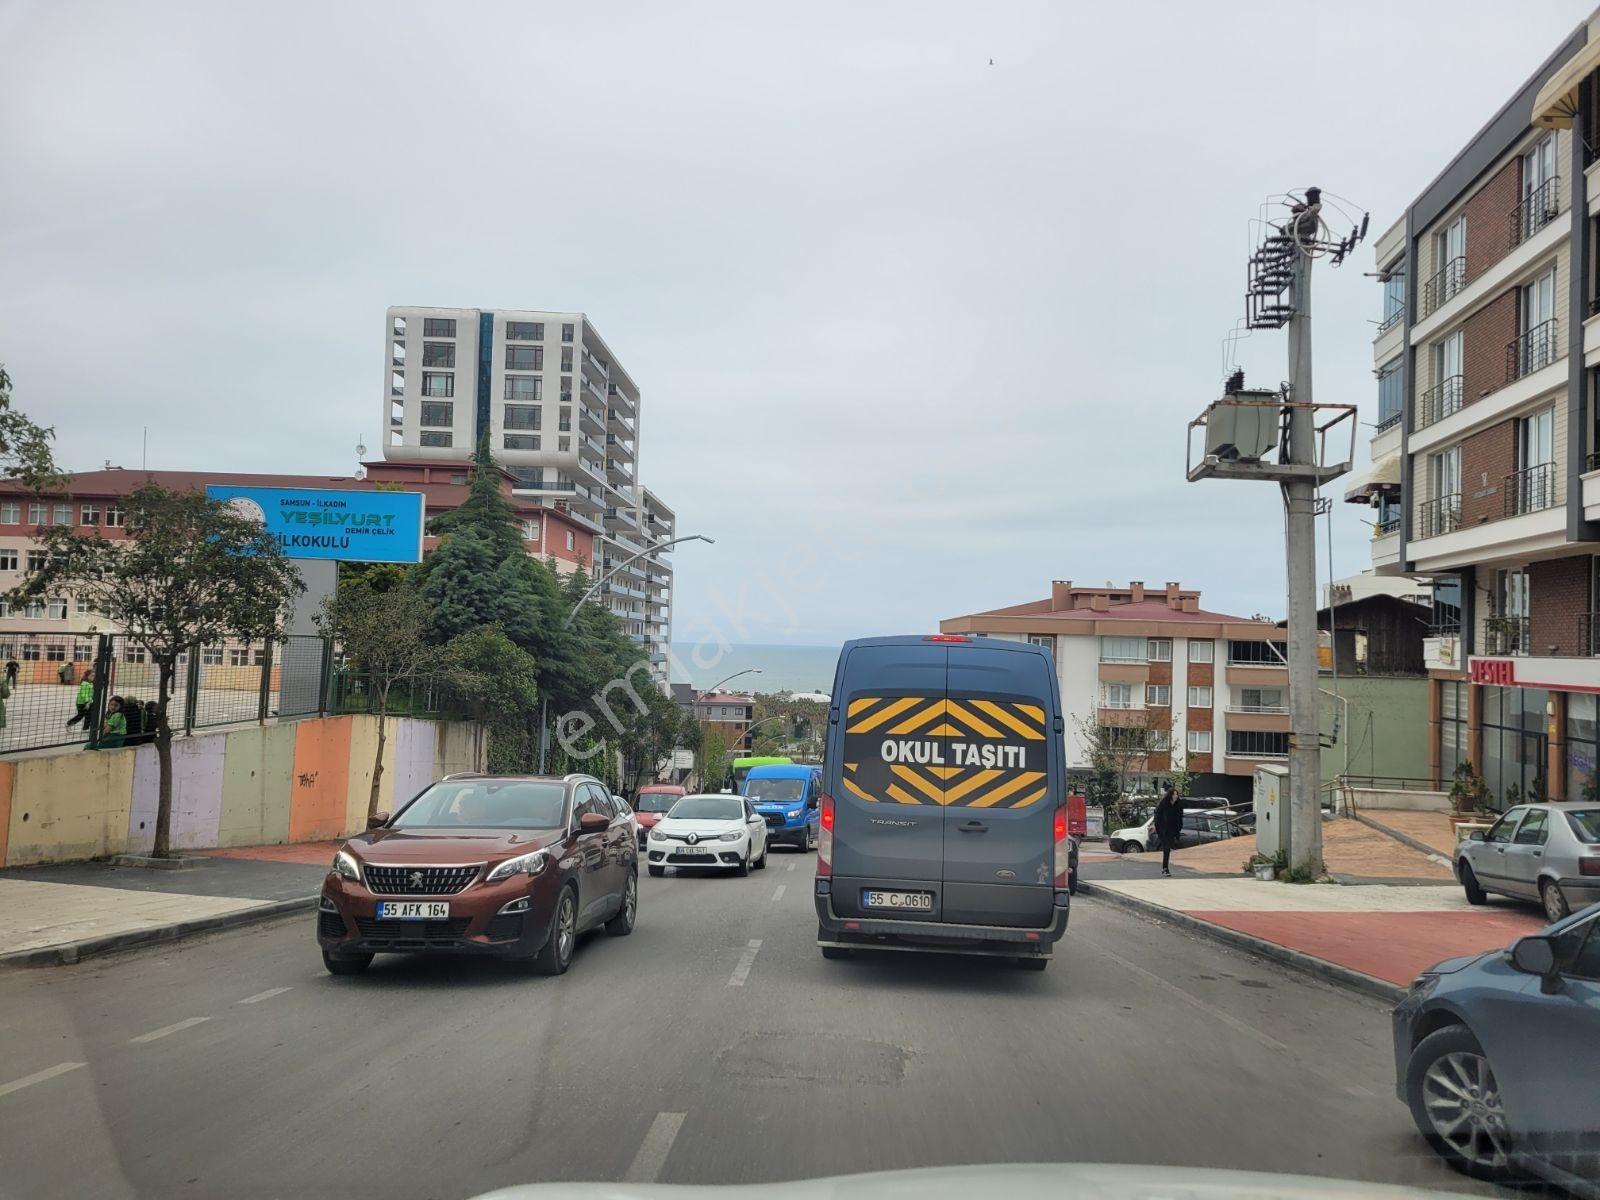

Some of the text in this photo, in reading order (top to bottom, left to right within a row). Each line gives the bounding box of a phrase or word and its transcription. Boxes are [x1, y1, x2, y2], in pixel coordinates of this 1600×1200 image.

[280, 499, 310, 507] SAMSUN
[316, 499, 347, 508] İLKADIM
[280, 508, 396, 528] YEŞİLYURT
[345, 527, 395, 536] DEMİR ÇELİK
[278, 532, 350, 549] İLKOKULU
[1471, 659, 1514, 685] VESTEL
[881, 739, 1026, 770] OKUL TAŞITI
[870, 893, 884, 905] 55
[904, 895, 930, 907] 0610
[384, 903, 446, 916] 55 AFK 164
